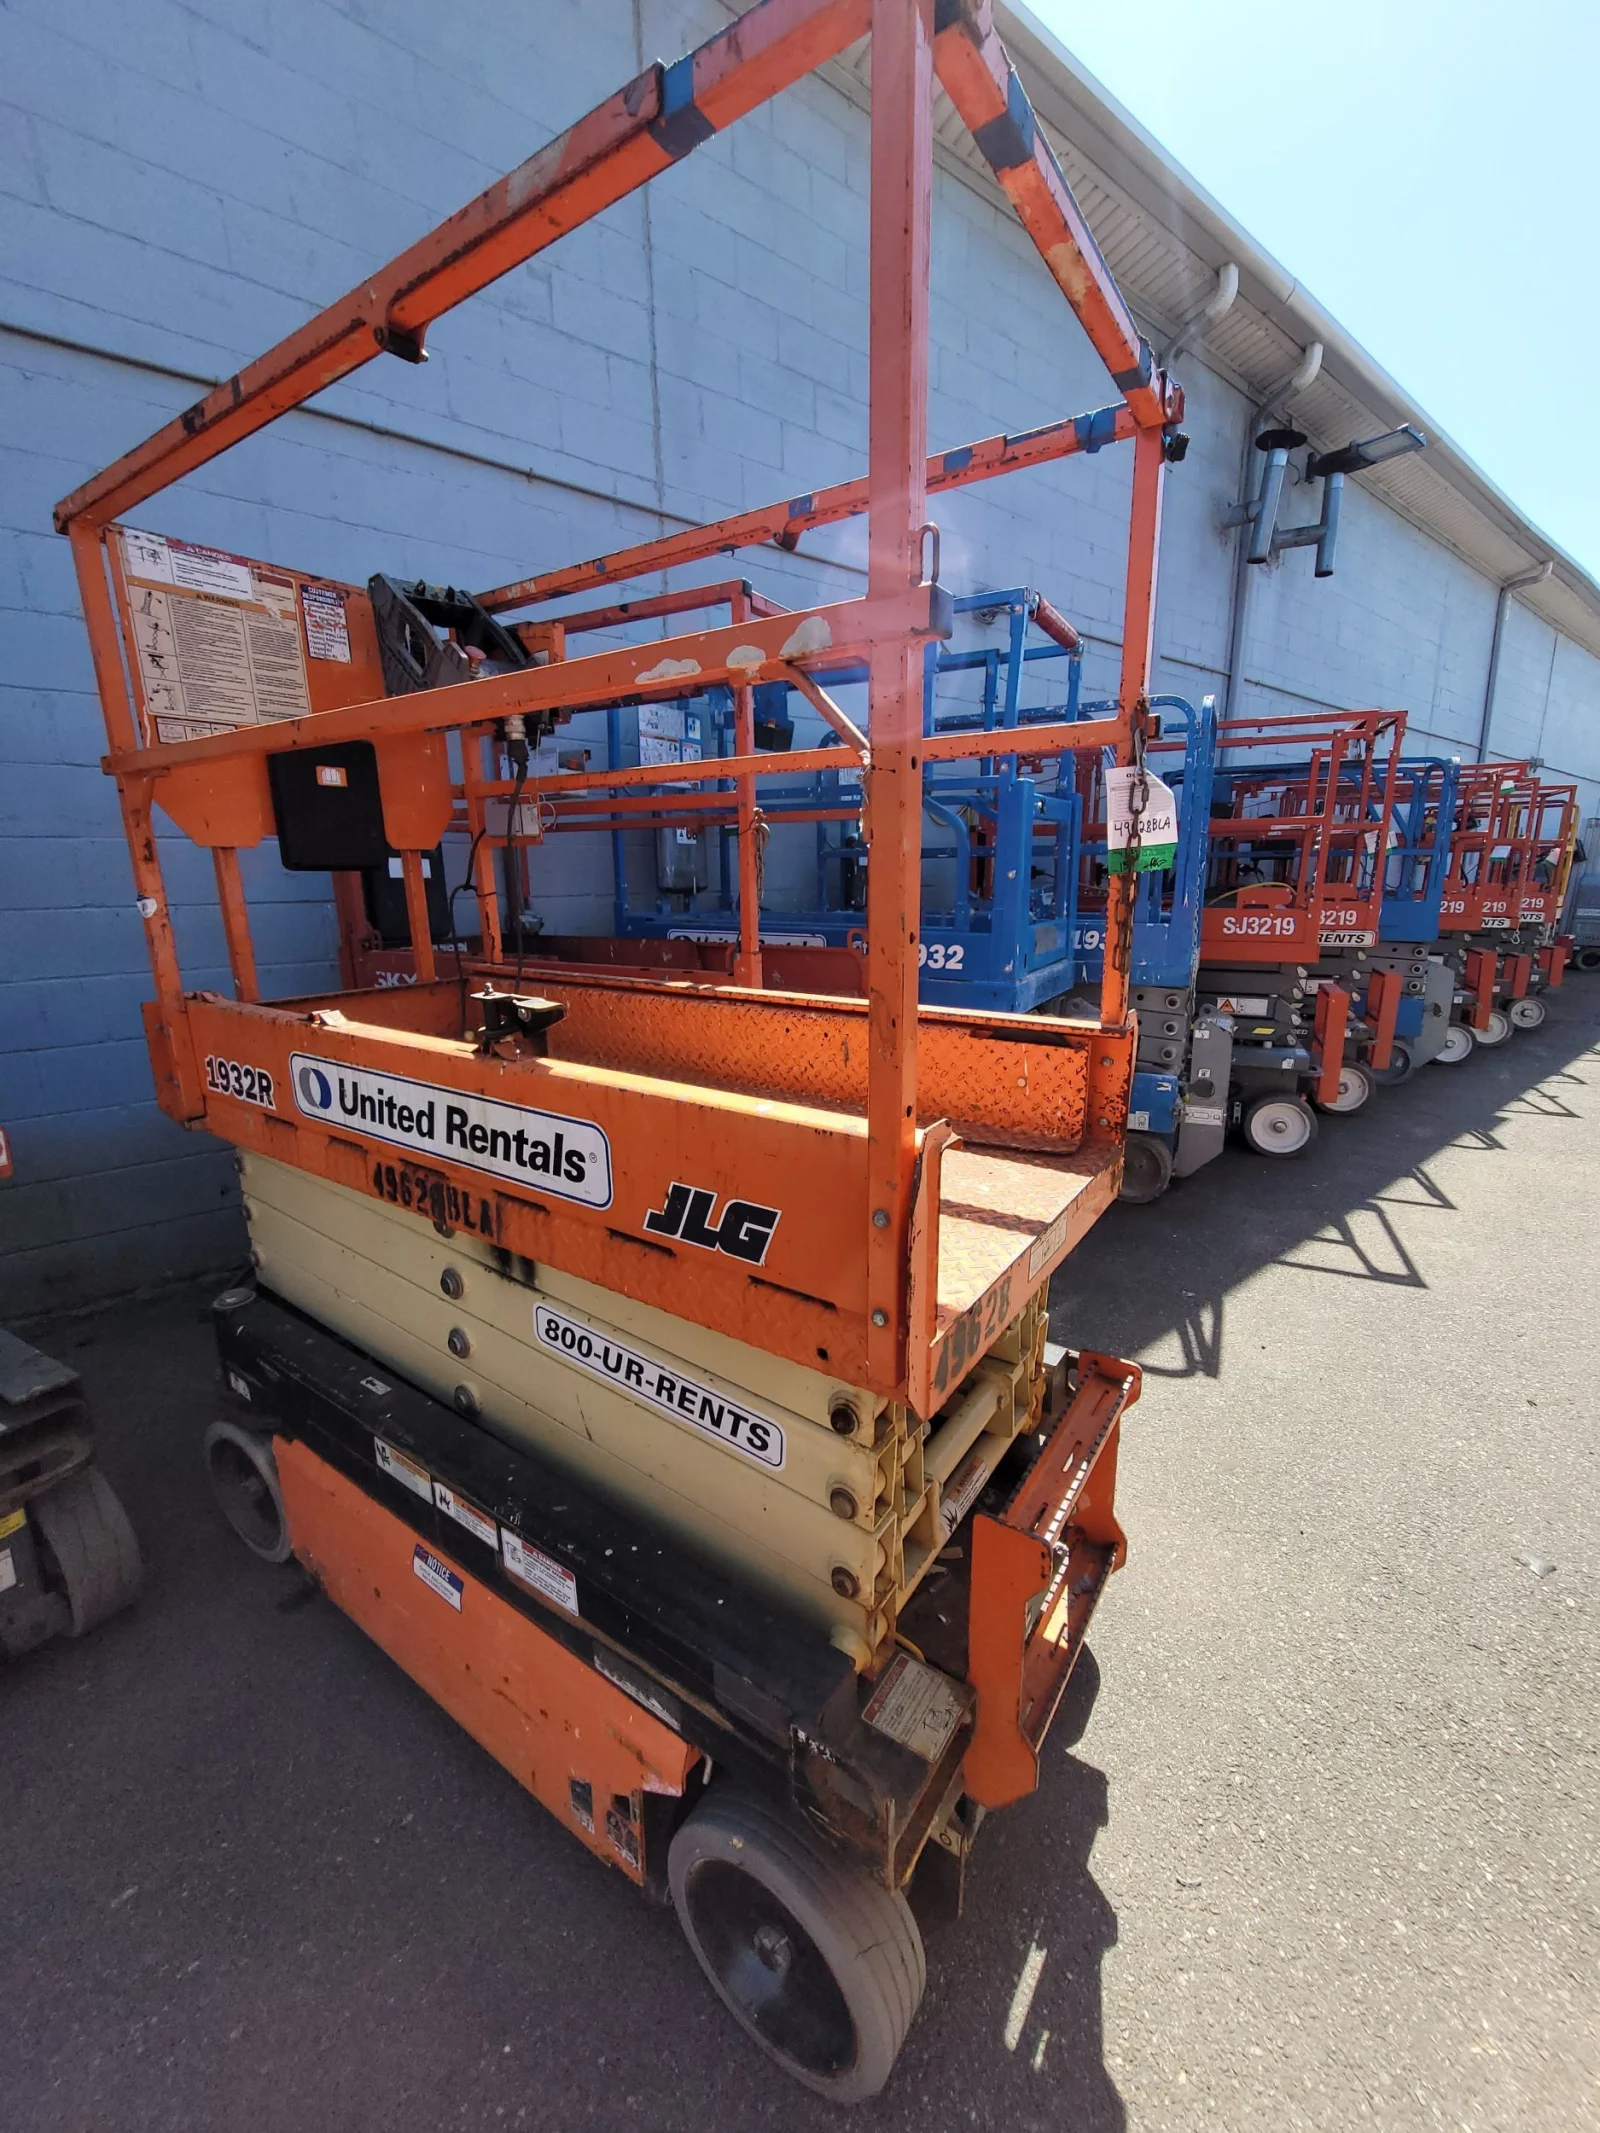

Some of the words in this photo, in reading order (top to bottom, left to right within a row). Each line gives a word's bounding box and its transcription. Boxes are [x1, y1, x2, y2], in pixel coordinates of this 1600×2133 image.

[1114, 817, 1171, 837] 4928BLA
[1440, 900, 1465, 913] 219
[1482, 901, 1507, 913] 219
[1521, 898, 1544, 908] 219
[1222, 916, 1296, 936] SJ3219
[206, 1056, 274, 1107] 1932R
[338, 1077, 435, 1140] United
[643, 1181, 782, 1266] JLG
[545, 1317, 772, 1453] 800-UR-RENTS
[427, 1554, 451, 1582] NOTICE
